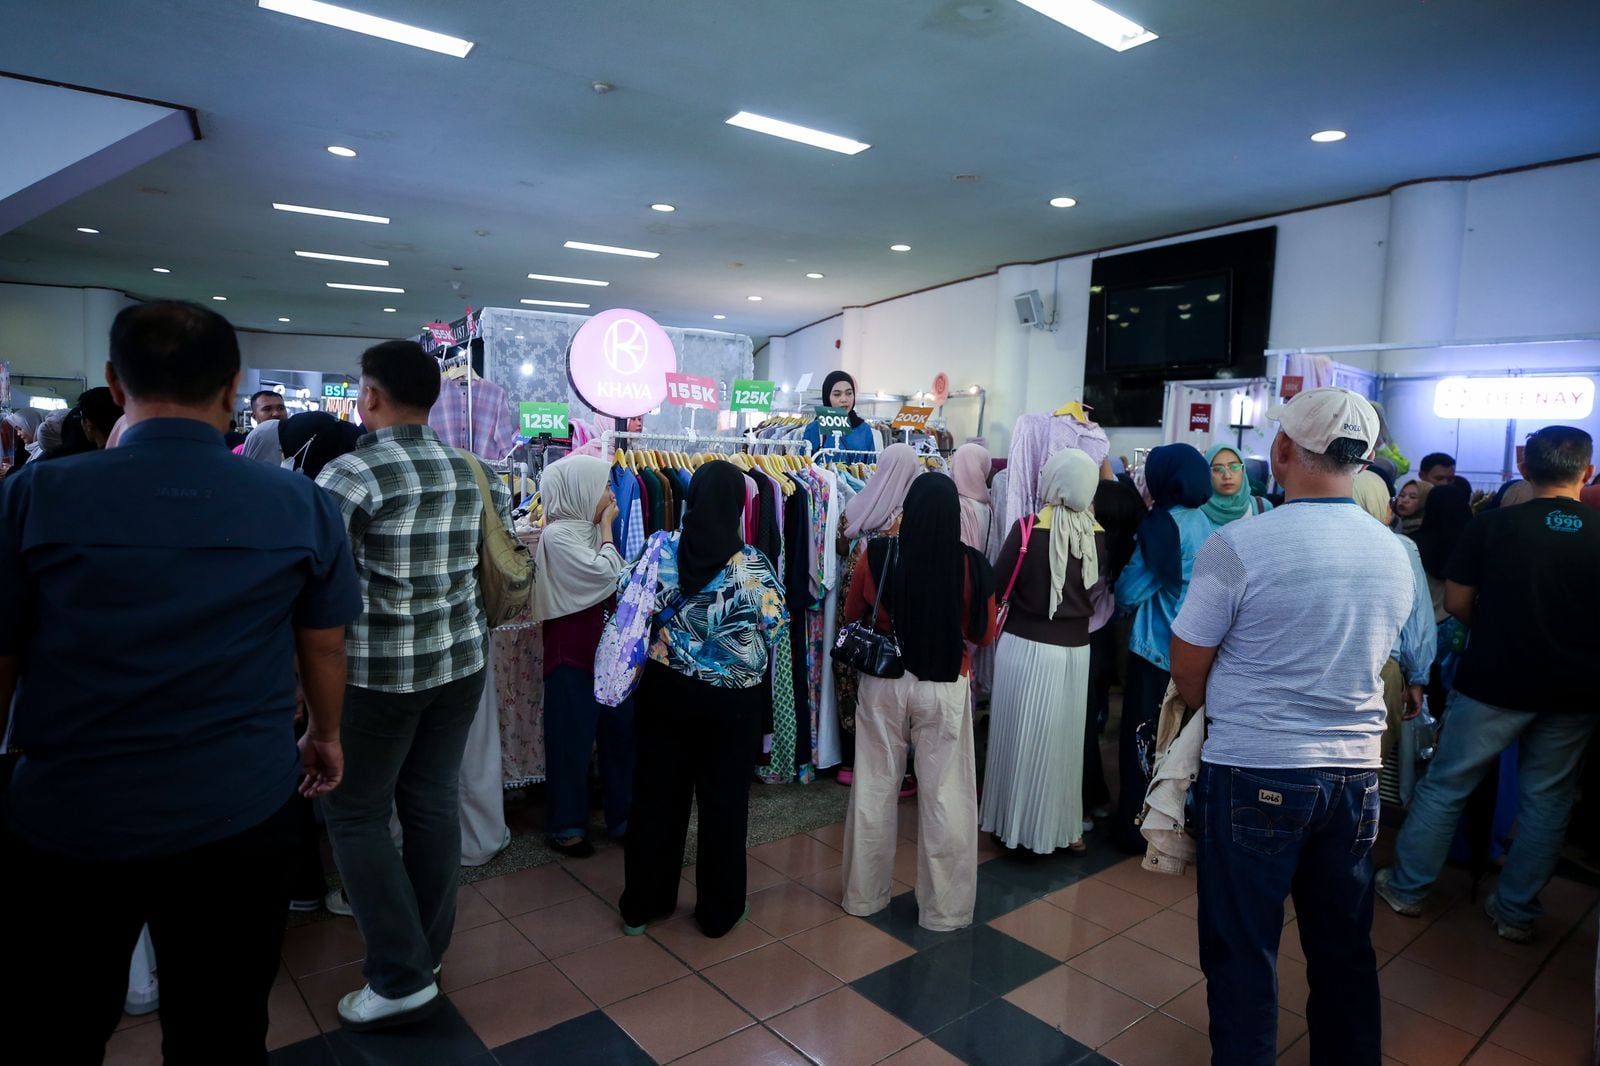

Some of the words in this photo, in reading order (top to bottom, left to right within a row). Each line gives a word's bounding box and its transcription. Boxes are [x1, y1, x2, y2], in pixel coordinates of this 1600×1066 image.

[325, 385, 345, 396] BSI
[597, 381, 652, 400] KHAYA
[668, 382, 716, 404] 155K
[735, 390, 770, 405] 125K
[522, 413, 566, 430] 125K
[818, 415, 850, 428] 300K
[896, 412, 928, 424] 200K
[1191, 416, 1209, 424] 200K
[1545, 516, 1583, 529] 1990
[1261, 792, 1280, 803] Lois
